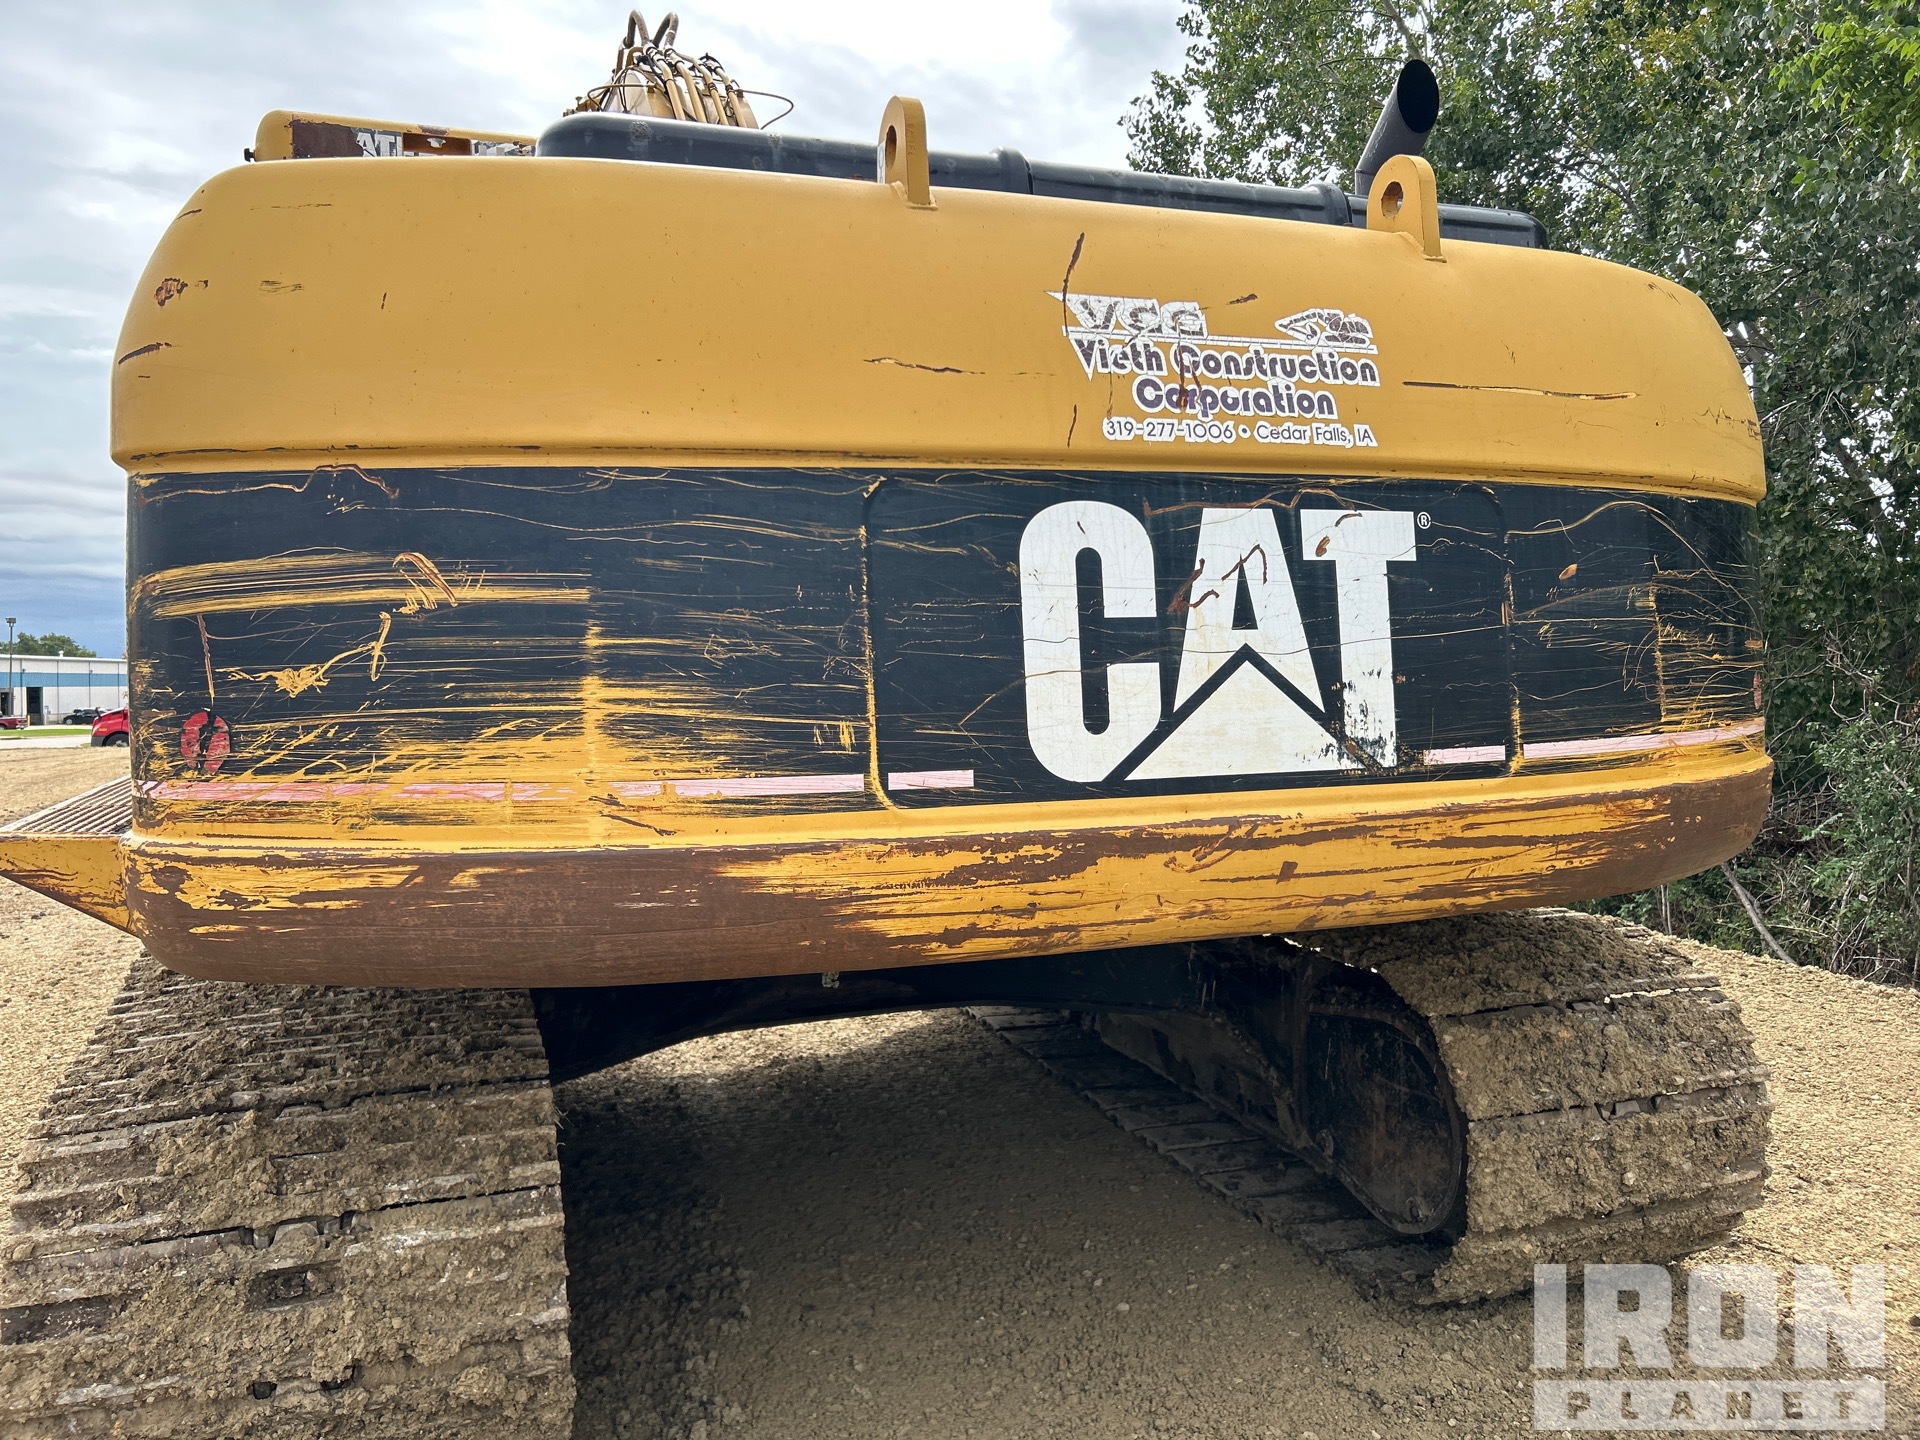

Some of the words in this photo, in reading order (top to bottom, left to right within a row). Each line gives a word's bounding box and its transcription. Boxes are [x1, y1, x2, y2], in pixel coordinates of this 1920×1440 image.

[1073, 338, 1165, 373] Vieth
[1173, 344, 1377, 382] Construction
[1136, 377, 1335, 418] Corporation
[1106, 420, 1233, 439] 319-277-1006
[1256, 424, 1308, 440] Cedar
[1315, 426, 1351, 444] Falls,
[1357, 428, 1373, 443] IA
[1019, 500, 1416, 782] CAT
